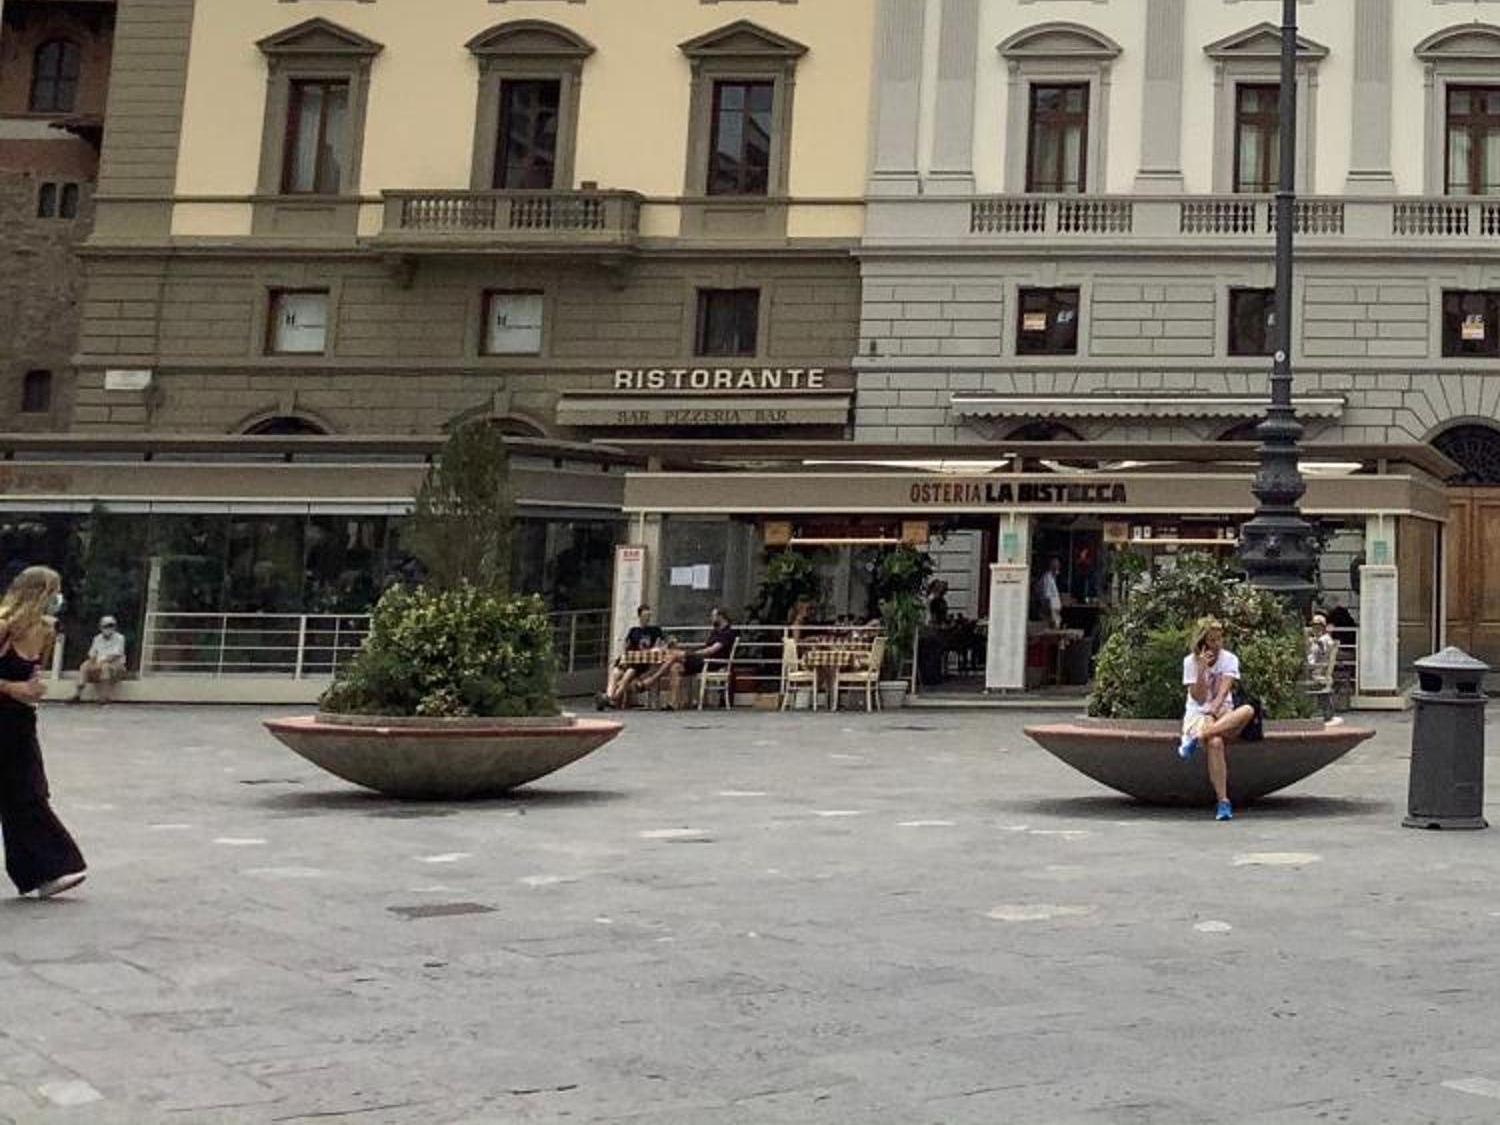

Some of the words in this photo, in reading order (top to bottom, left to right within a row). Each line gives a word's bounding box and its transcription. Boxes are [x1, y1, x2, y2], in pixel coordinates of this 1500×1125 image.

[614, 369, 825, 389] RISTORANTE
[617, 410, 649, 423] BAR
[665, 410, 741, 422] PIZZERIA
[755, 409, 788, 422] BAR
[909, 482, 981, 503] OSTERIA
[985, 482, 1014, 503] LA
[1018, 482, 1127, 504] BISTECCA
